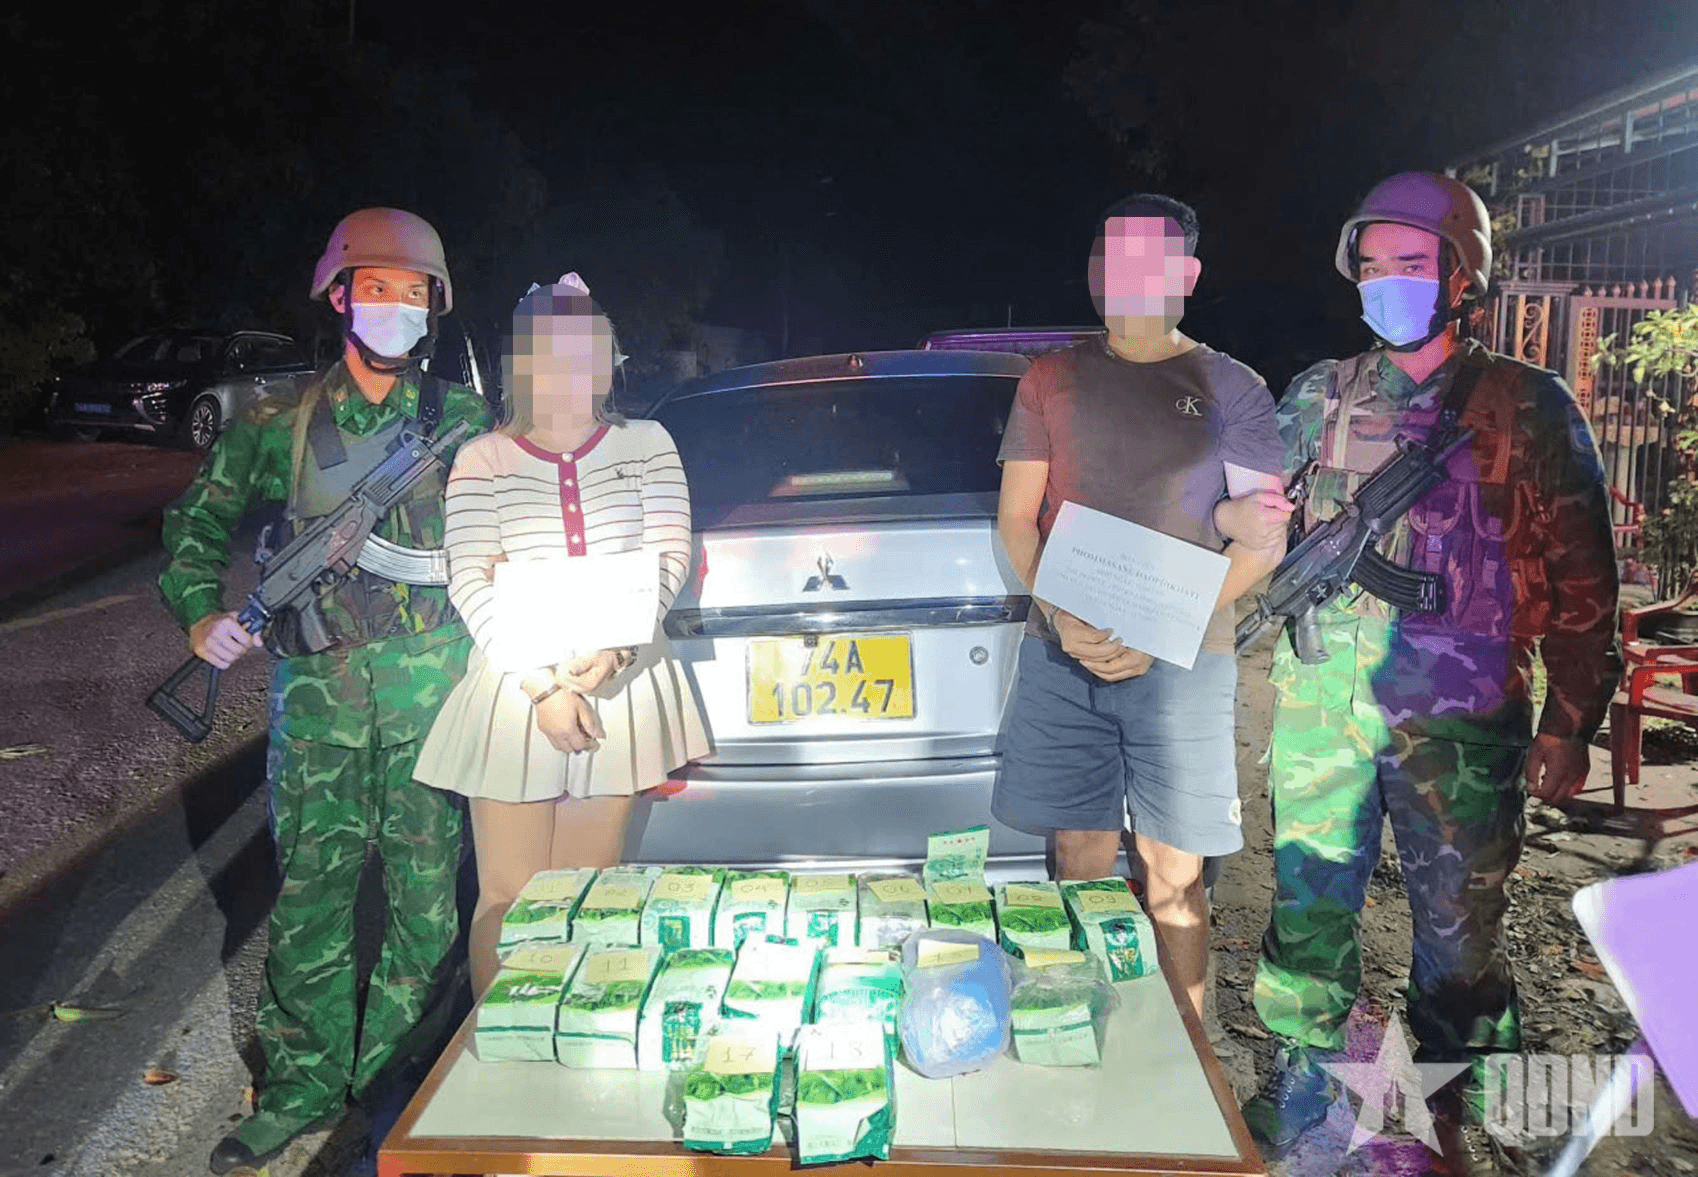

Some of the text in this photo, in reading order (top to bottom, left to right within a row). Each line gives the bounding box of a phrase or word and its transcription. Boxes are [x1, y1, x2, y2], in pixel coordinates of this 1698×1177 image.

[772, 678, 895, 717] 102.47
[668, 882, 694, 893] 03
[1089, 895, 1117, 904] 09
[602, 957, 628, 972] 11
[723, 1047, 756, 1063] 17
